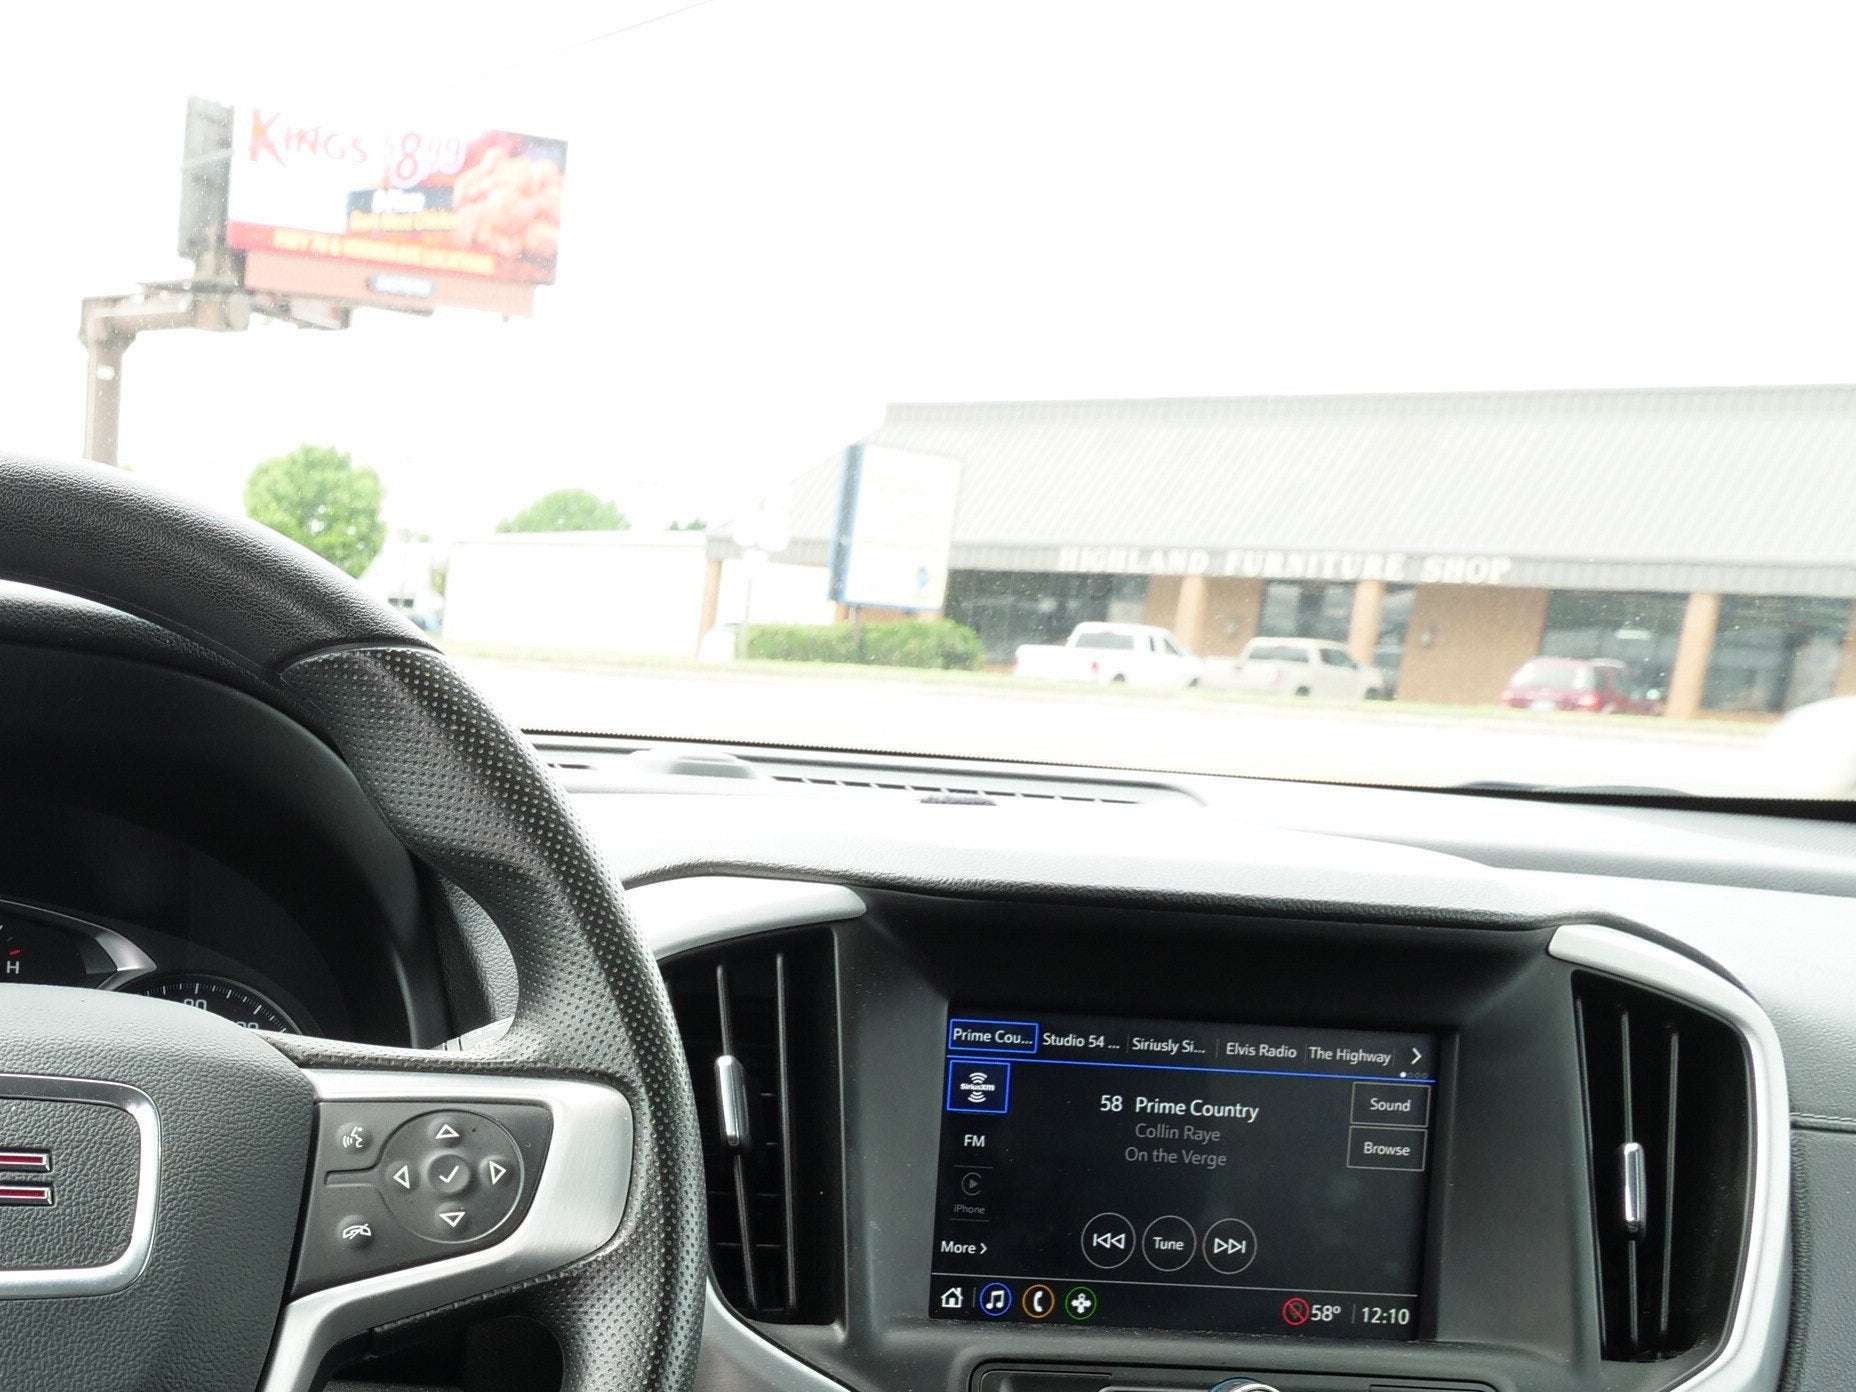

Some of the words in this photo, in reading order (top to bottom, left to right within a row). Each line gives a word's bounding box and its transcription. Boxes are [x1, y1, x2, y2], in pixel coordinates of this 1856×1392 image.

[1057, 545, 1209, 574] HIGHLAND
[1224, 549, 1408, 581] FURNITURE
[1419, 555, 1512, 585] SHOP
[6, 960, 20, 975] H
[952, 1028, 992, 1043] Prime
[1042, 1032, 1085, 1048] Studio
[1088, 1034, 1105, 1048] 54
[1132, 1037, 1179, 1055] Siriusly
[1226, 1042, 1256, 1056] Elvis
[1259, 1043, 1297, 1059] Radio
[1308, 1046, 1333, 1061] The
[1336, 1048, 1391, 1066] Highway
[1100, 1094, 1123, 1112] 58
[1135, 1096, 1186, 1116] Prime
[1190, 1099, 1260, 1124] Country
[1369, 1097, 1412, 1112] Sound
[963, 1134, 986, 1148] FM
[1135, 1123, 1179, 1140] Collin
[1184, 1125, 1221, 1145] Raye
[1363, 1141, 1411, 1157] Browse
[1125, 1146, 1148, 1162] On
[1152, 1147, 1178, 1164] the
[1183, 1150, 1227, 1170] Verge
[953, 1203, 986, 1215] iPhone
[940, 1240, 976, 1255] More
[1152, 1236, 1185, 1251] Tune
[1361, 1307, 1410, 1325] 12:10
